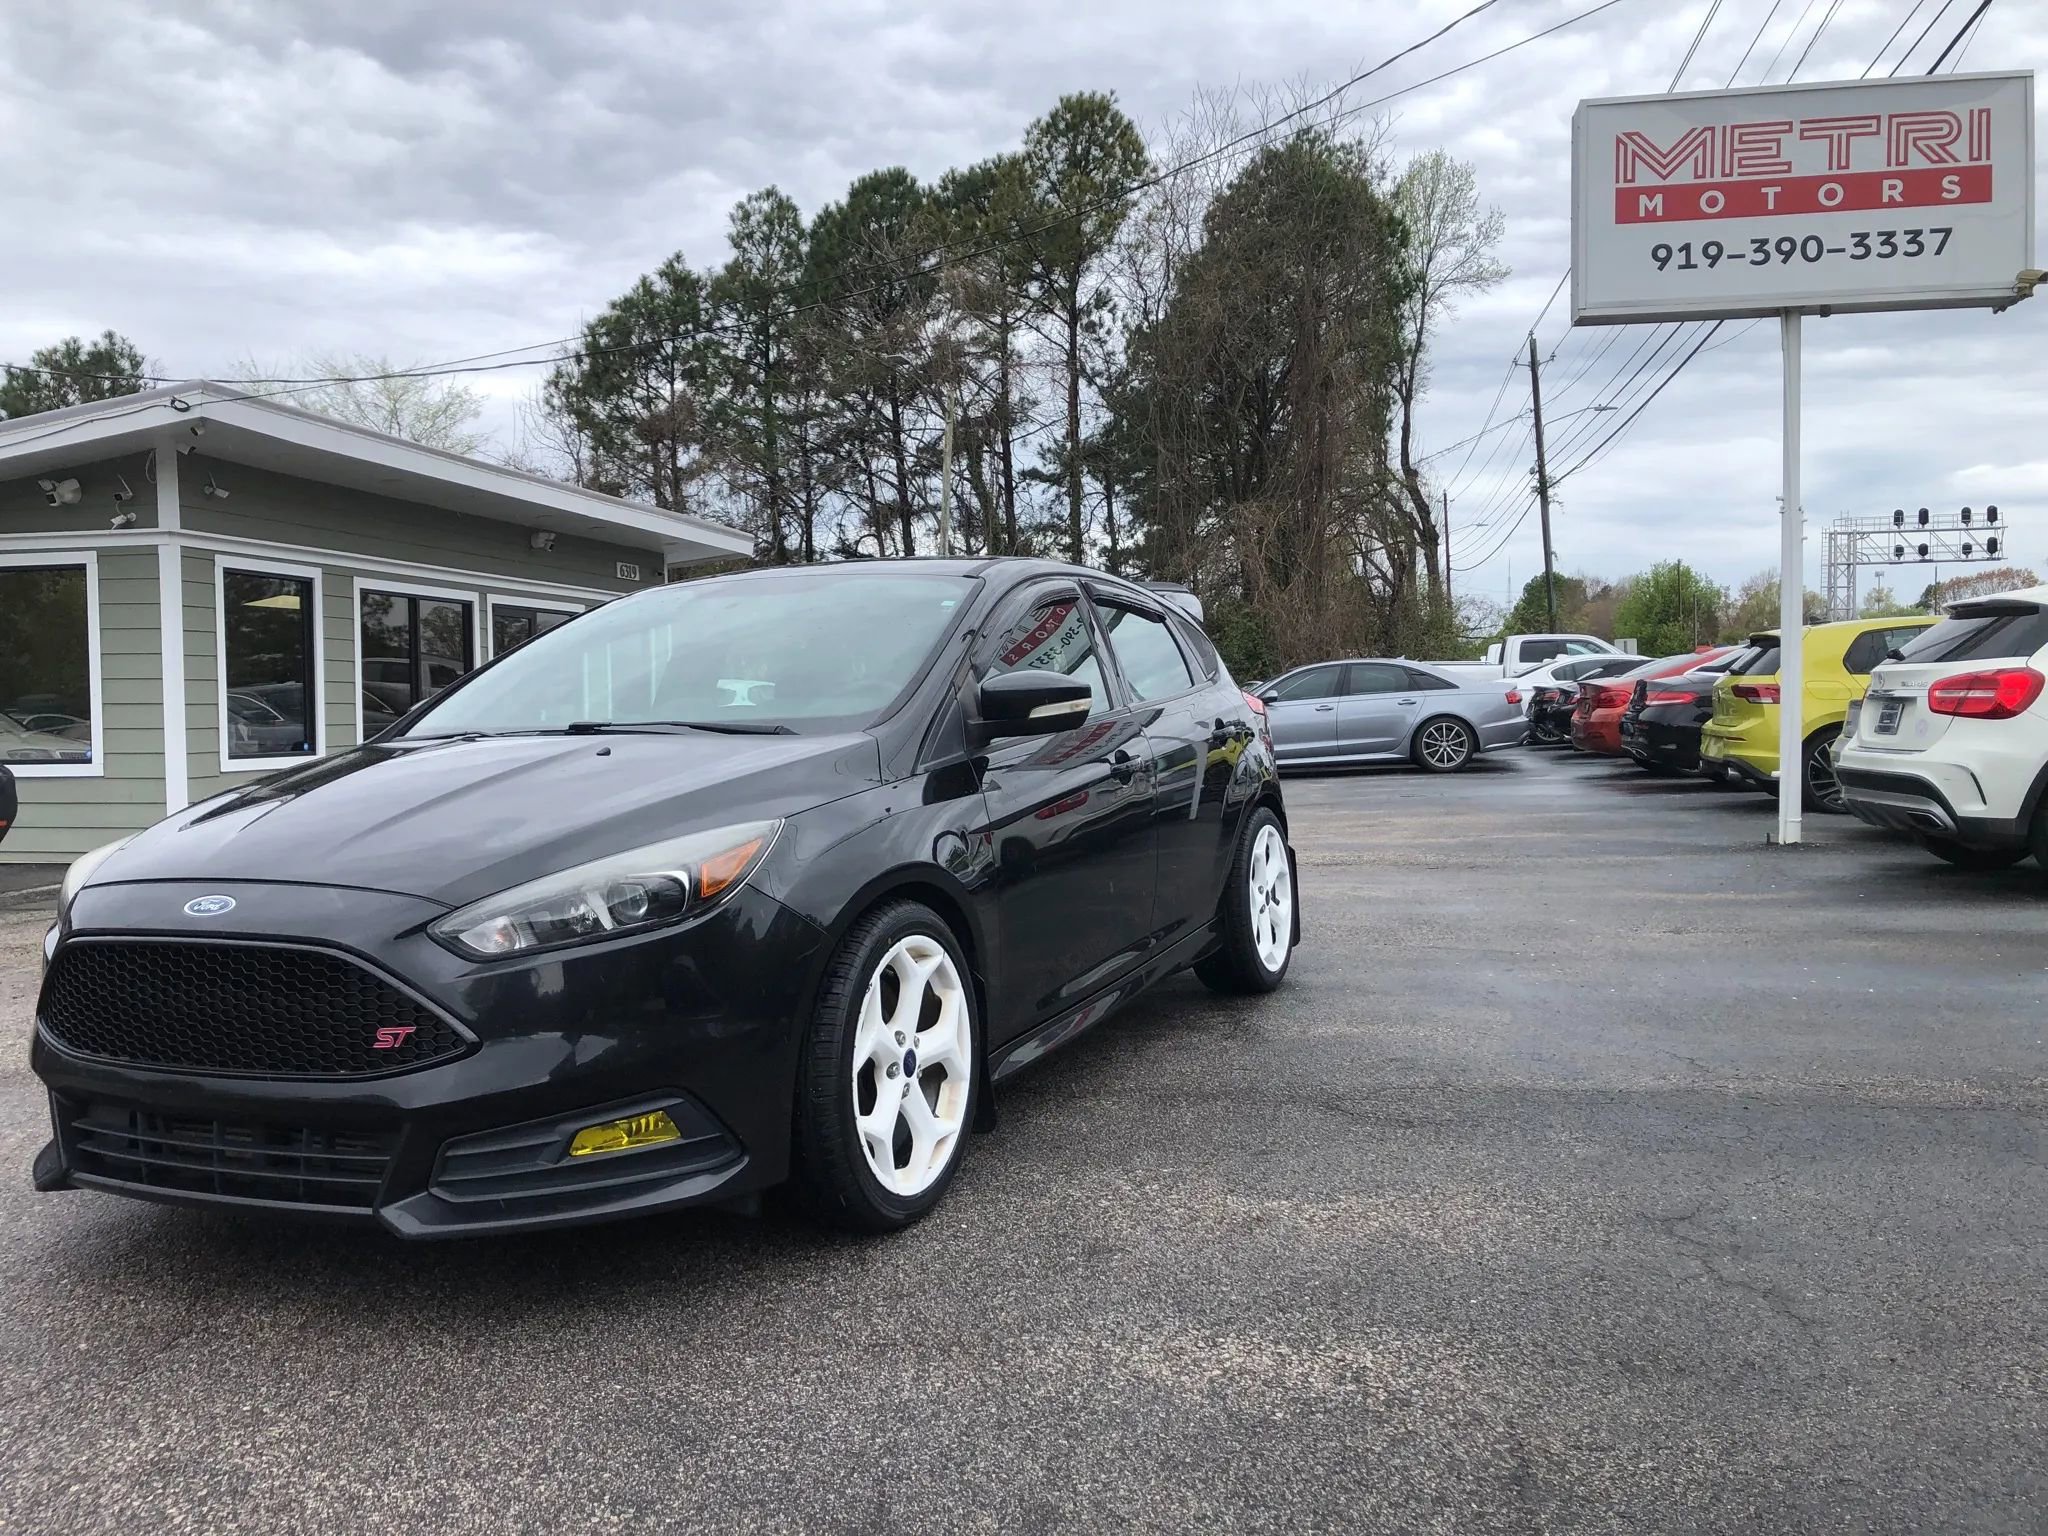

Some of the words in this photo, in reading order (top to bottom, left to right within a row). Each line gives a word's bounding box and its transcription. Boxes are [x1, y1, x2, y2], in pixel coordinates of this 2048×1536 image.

[1615, 108, 1992, 184] METRI
[1638, 175, 1962, 218] MOTORS
[1651, 227, 1954, 272] 919-390-3337
[619, 564, 637, 579] 6319
[372, 1026, 417, 1048] ST
